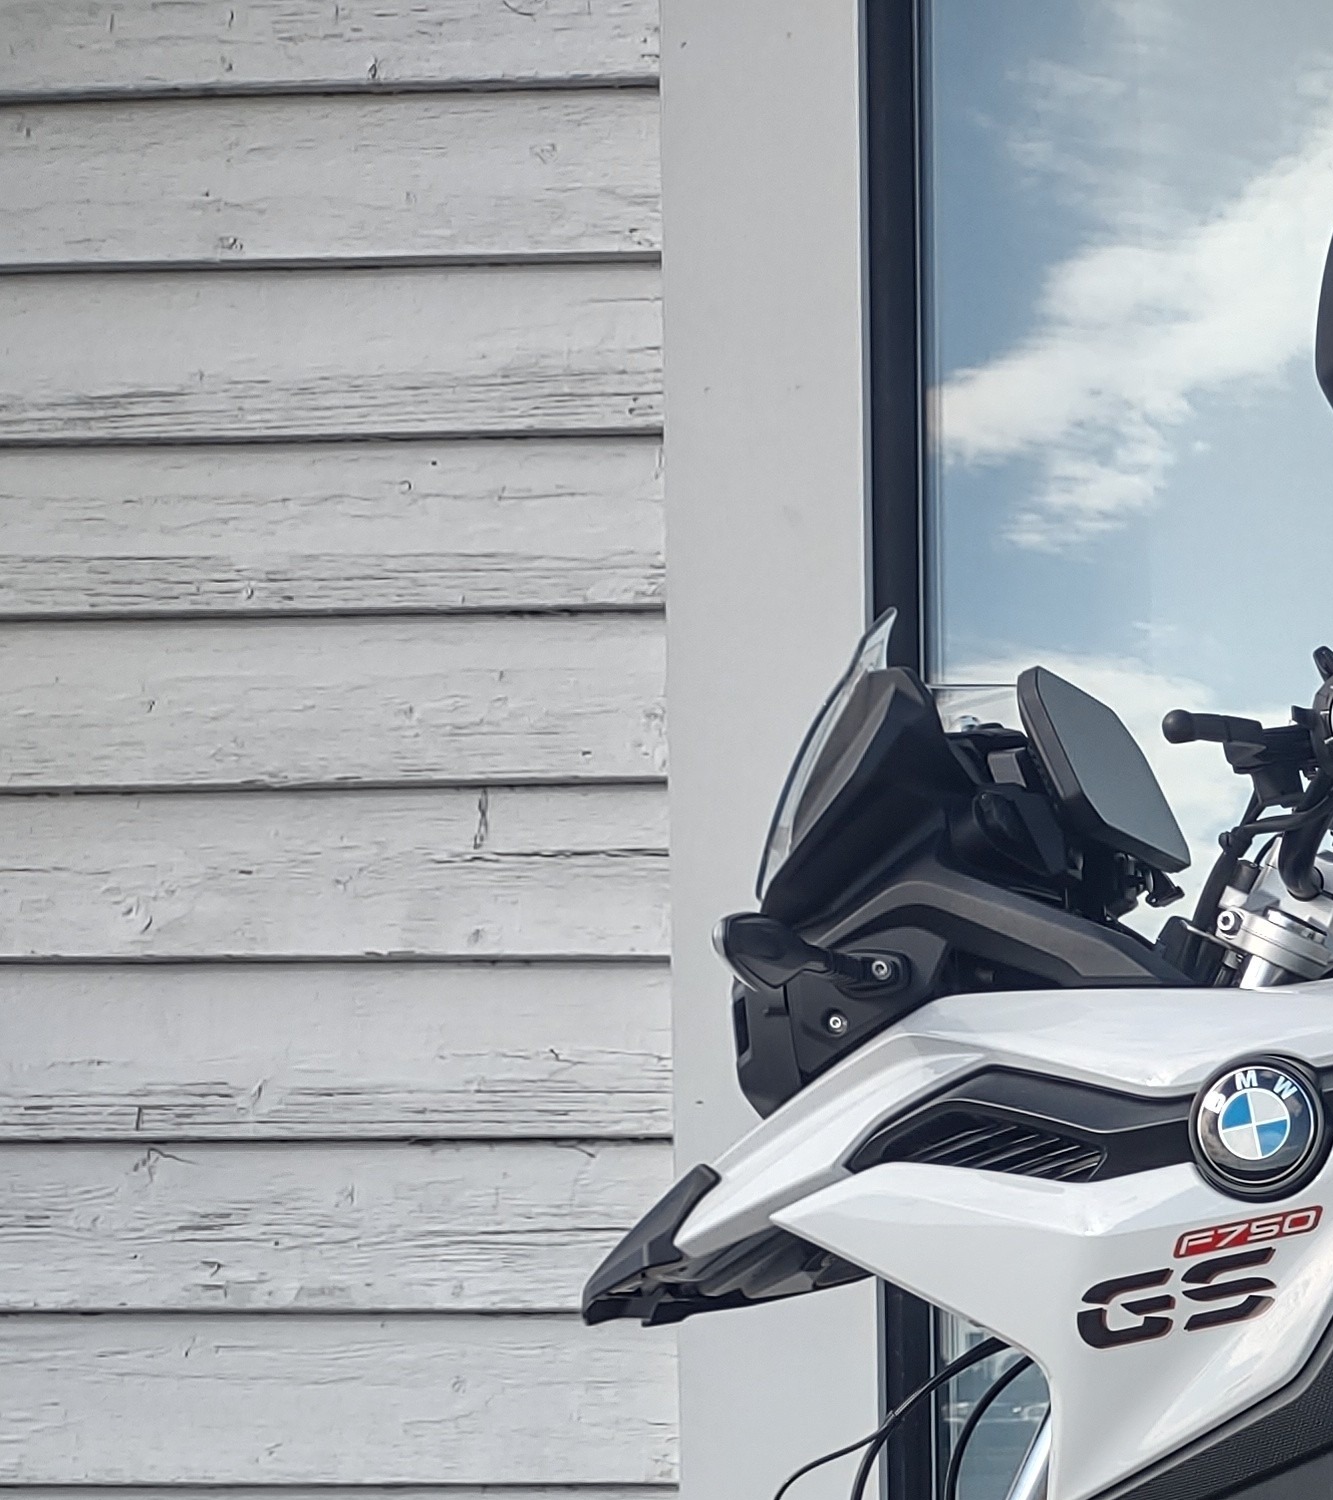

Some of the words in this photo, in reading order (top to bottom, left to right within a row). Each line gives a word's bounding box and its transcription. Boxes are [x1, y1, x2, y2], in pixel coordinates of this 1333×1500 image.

[1203, 1069, 1298, 1114] BMW
[1179, 1209, 1318, 1257] F750
[1076, 1246, 1277, 1350] GS
